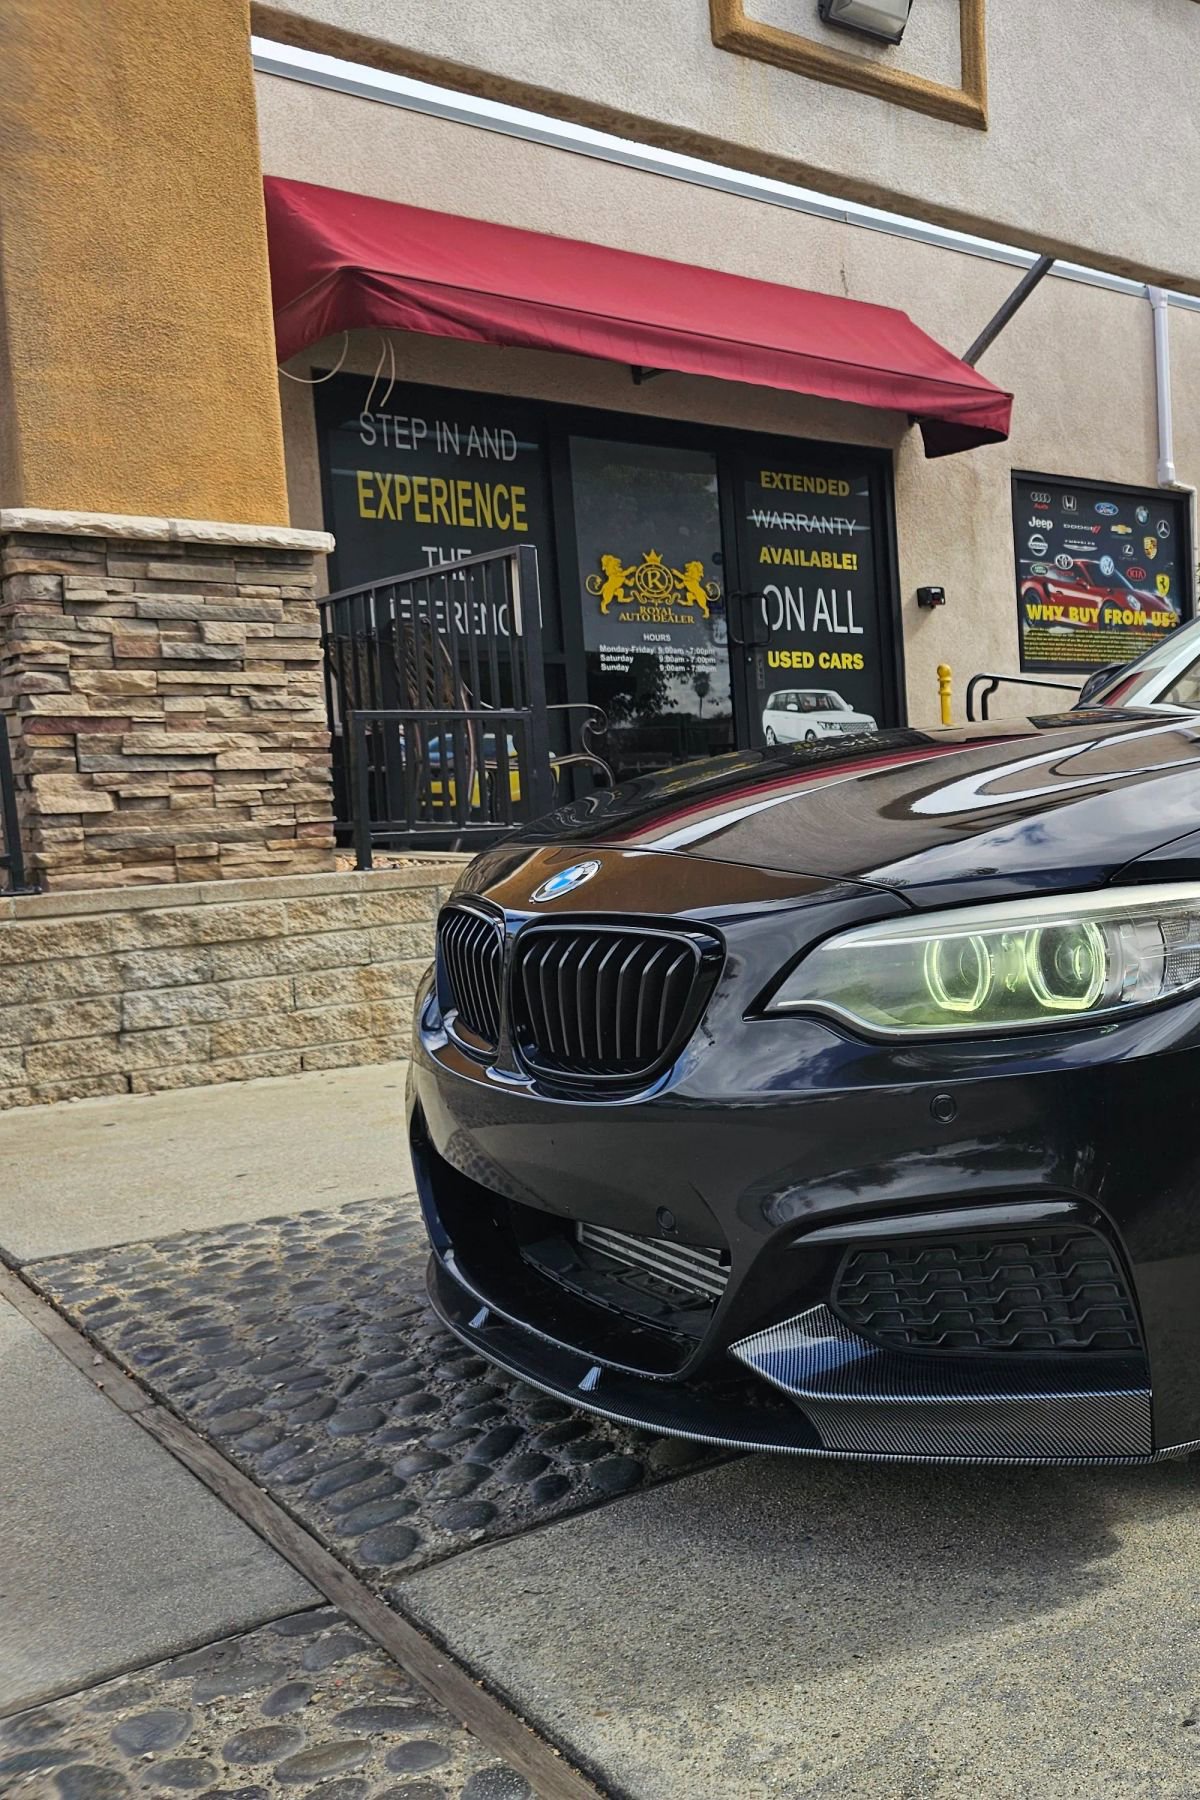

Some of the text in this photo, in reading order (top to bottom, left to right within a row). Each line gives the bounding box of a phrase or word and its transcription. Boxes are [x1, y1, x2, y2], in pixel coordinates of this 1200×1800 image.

[360, 411, 517, 462] STEP IN AND
[759, 471, 850, 497] EXTENDED
[356, 470, 529, 531] EXPERIENCE
[752, 509, 857, 537] WARRANTY
[1028, 515, 1054, 531] Jeep
[759, 546, 858, 571] AVAILABLE!
[619, 612, 695, 624] AUTO DEALER
[640, 606, 674, 617] ROYAL
[761, 584, 864, 634] ON ALL
[1026, 604, 1178, 627] WHY BUY FROM US?
[643, 633, 671, 641] HOURS
[600, 653, 634, 664] Saturday
[600, 663, 630, 673] Sunday
[767, 650, 865, 670] USED CARS
